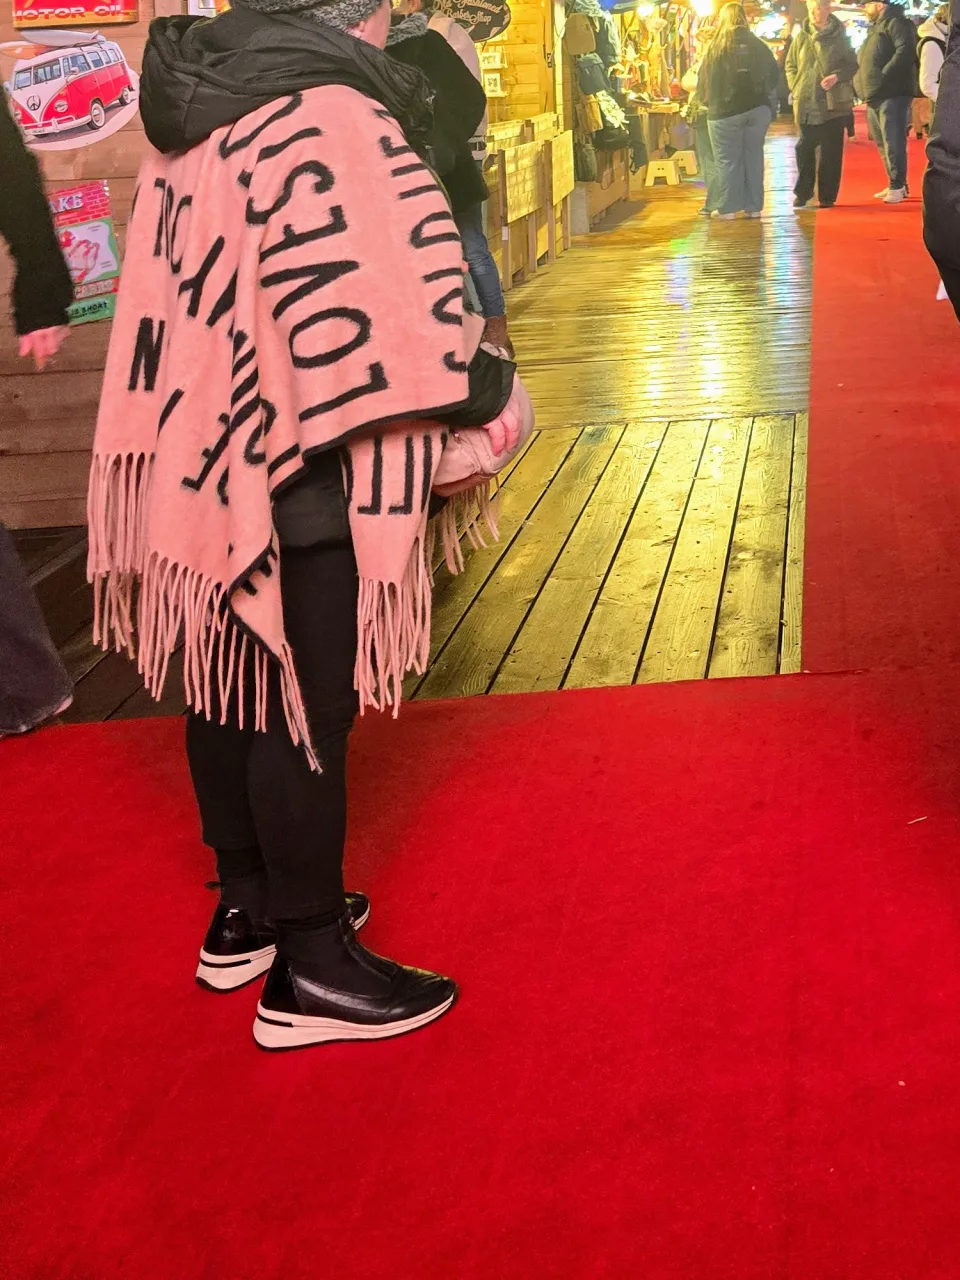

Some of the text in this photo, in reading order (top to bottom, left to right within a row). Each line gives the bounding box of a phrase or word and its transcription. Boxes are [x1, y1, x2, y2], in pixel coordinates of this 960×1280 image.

[443, 8, 492, 25] Barber Shop
[50, 192, 83, 213] AKE
